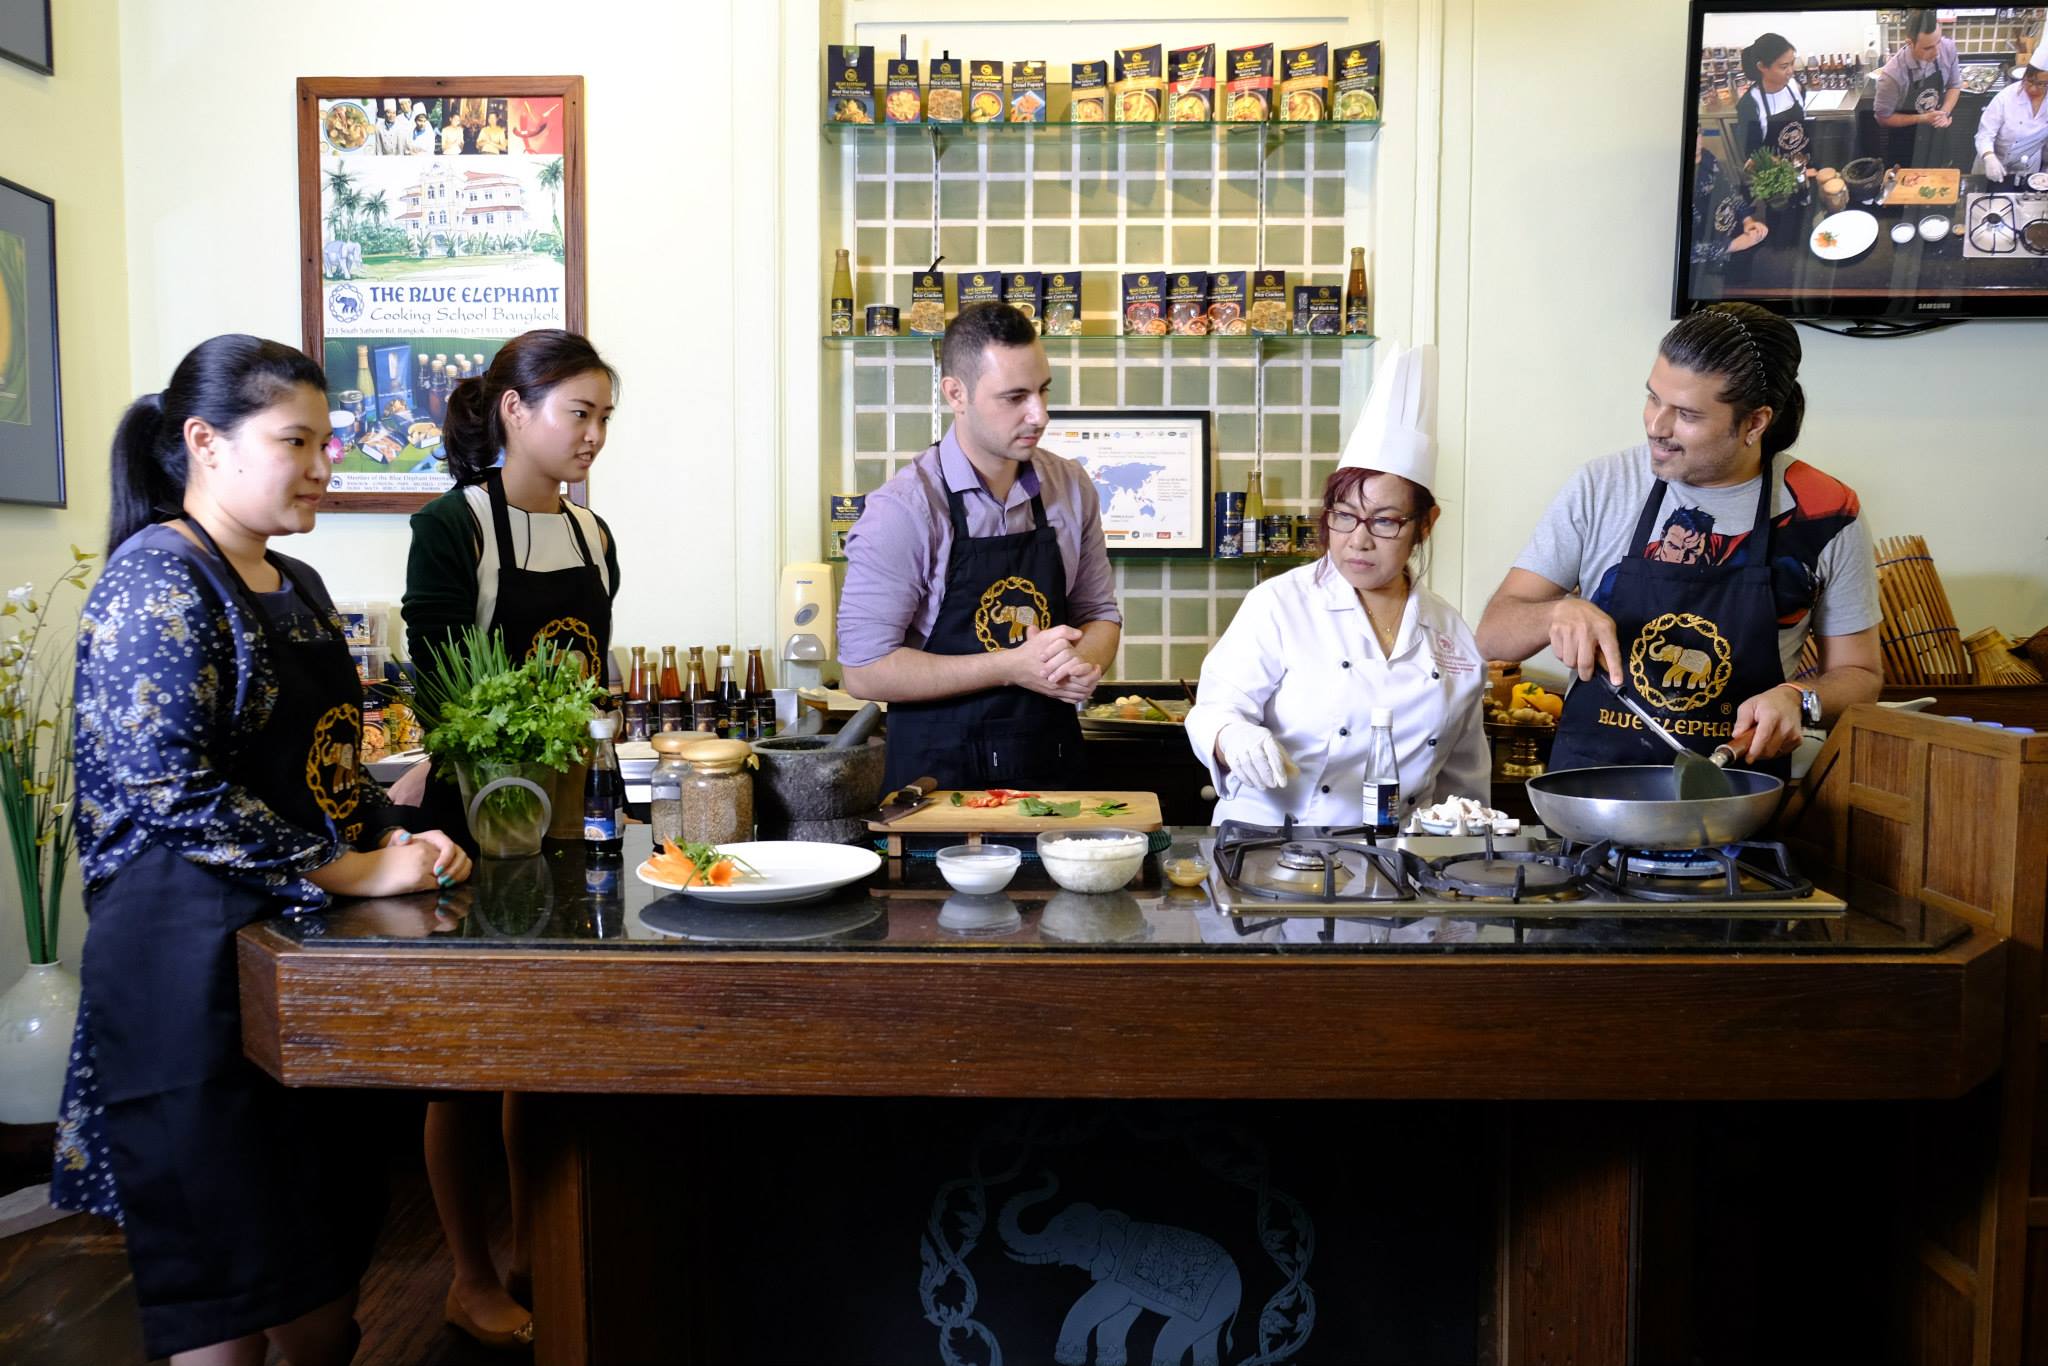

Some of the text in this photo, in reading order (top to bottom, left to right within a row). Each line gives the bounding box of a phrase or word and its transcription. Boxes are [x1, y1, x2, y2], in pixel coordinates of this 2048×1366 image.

[370, 287, 560, 303] THE BLUE ELEPHANT
[370, 307, 560, 325] Cooking School Bangkok
[398, 328, 424, 336] Bangkok
[1598, 709, 1643, 730] BLUE
